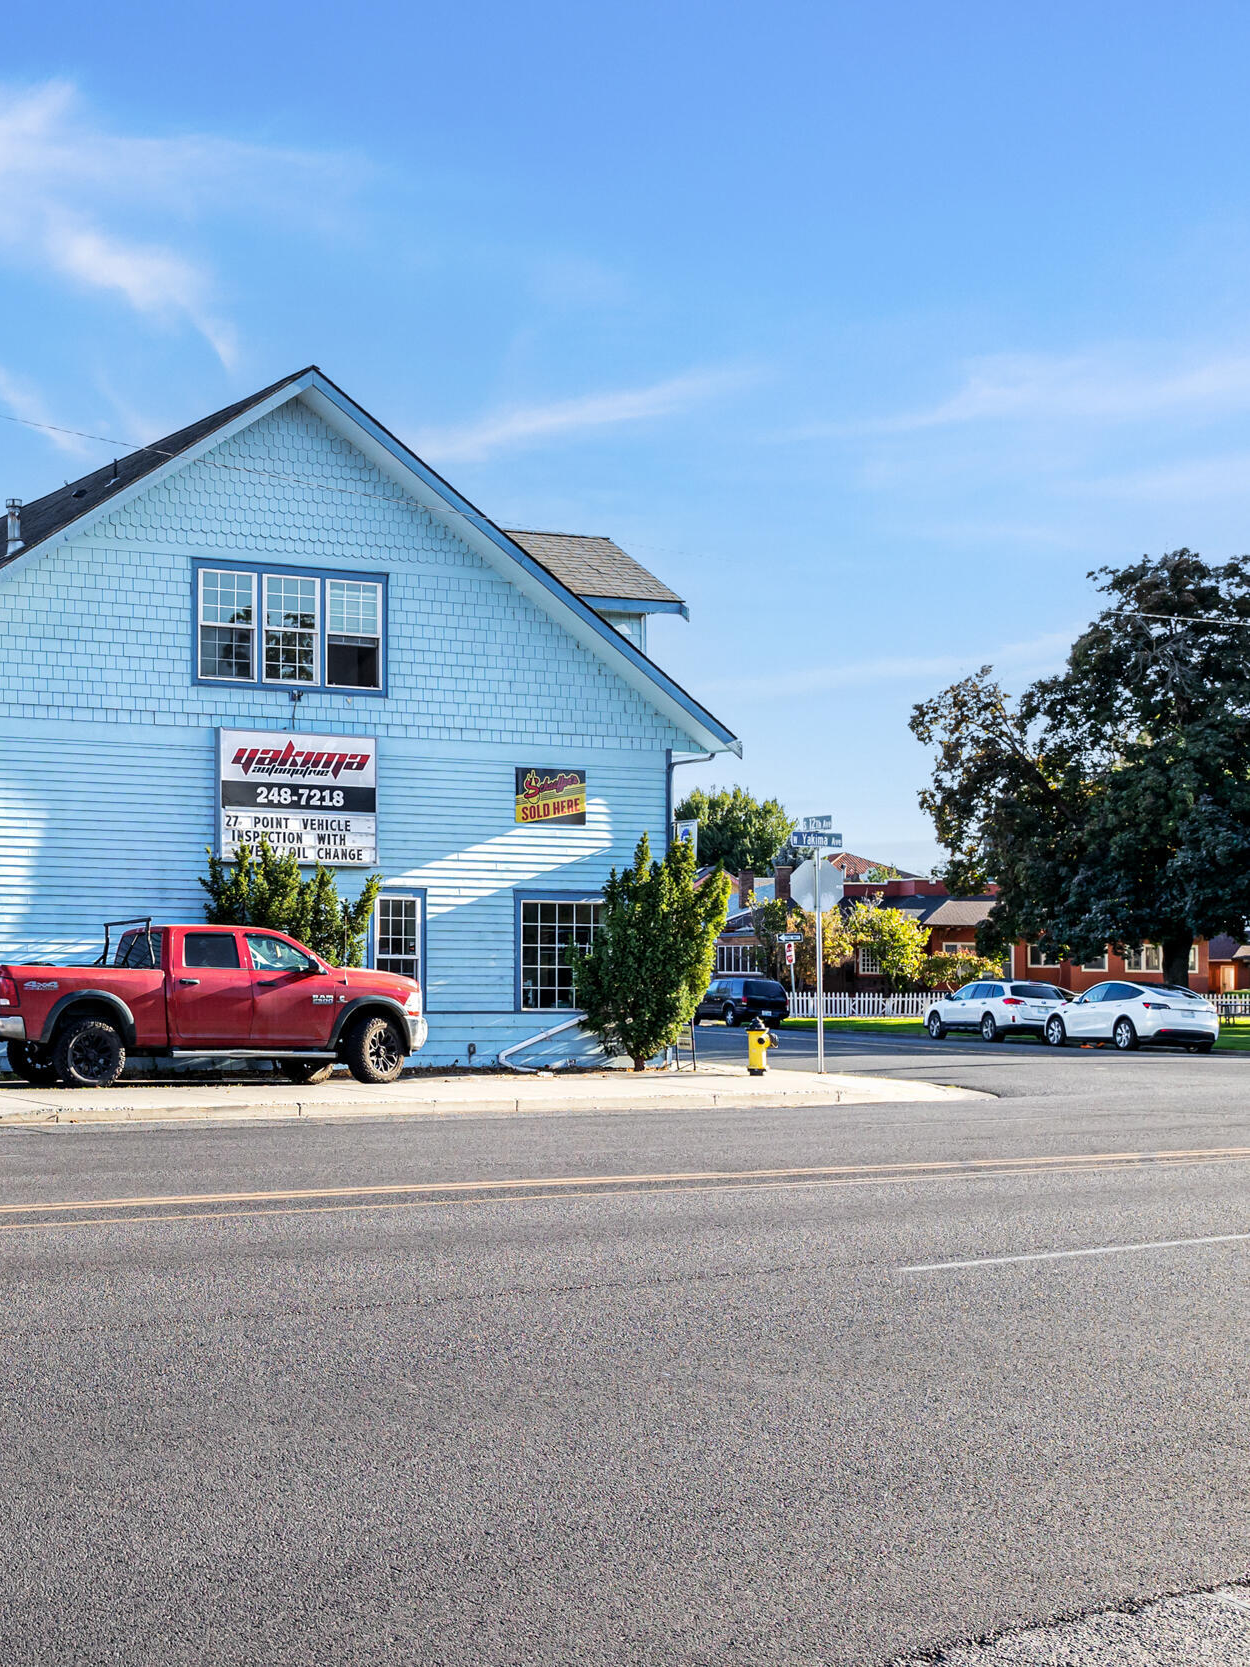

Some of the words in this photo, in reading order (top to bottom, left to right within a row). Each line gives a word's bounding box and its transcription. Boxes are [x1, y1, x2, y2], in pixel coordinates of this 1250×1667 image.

[256, 787, 345, 807] 248-7218
[521, 803, 550, 820] SOLD
[552, 798, 580, 815] HERE
[225, 815, 239, 827] 27
[253, 816, 290, 829] POINT
[302, 818, 350, 831] VEHICLE
[317, 833, 346, 846] WITH
[802, 833, 828, 845] Yakima
[832, 837, 842, 846] Ave
[288, 846, 309, 859] OIL
[317, 847, 363, 861] CHANGE
